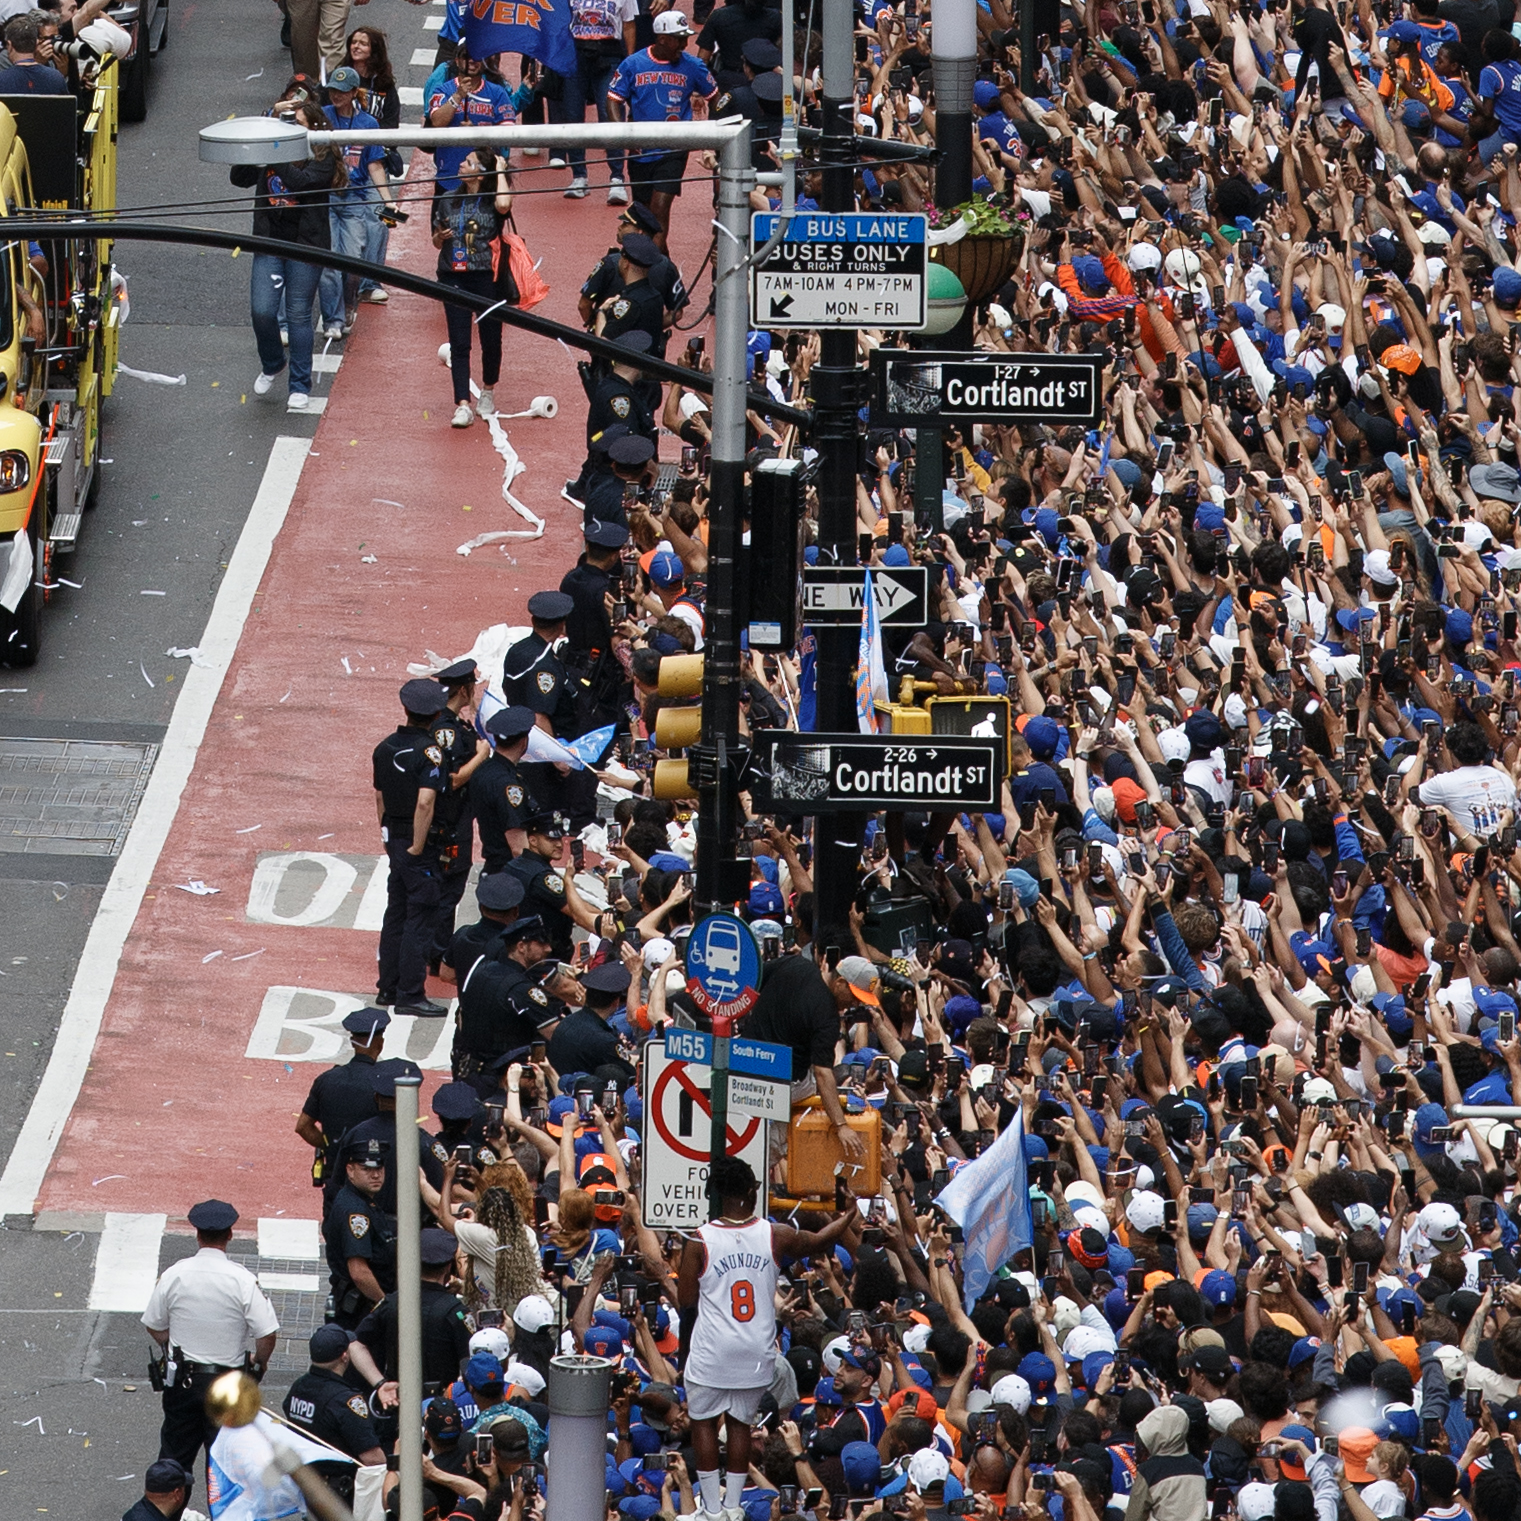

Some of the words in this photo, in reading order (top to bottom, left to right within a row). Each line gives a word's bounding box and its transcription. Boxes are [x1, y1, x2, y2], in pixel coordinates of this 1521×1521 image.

[635, 72, 659, 87] NEW
[660, 72, 688, 87] YORK
[807, 220, 846, 237] BUS
[853, 220, 909, 239] LANE
[770, 244, 846, 261] BUSES
[854, 244, 911, 262] ONLY
[792, 261, 802, 271] &
[807, 261, 842, 271] RIGHT
[846, 261, 886, 272] TURNS
[825, 301, 858, 316] MON
[874, 302, 899, 316] FRI
[993, 365, 1020, 378] 1-27
[947, 379, 1065, 408] Cortlandt
[1068, 381, 1088, 398] ST
[849, 586, 900, 609] WAY
[883, 747, 918, 763] 2-26
[835, 762, 963, 794] Cortlandt
[965, 765, 986, 784] ST
[686, 984, 706, 1004] NO
[705, 990, 756, 1017] STANDING
[668, 1033, 706, 1060] M55
[733, 1044, 755, 1061] South
[755, 1047, 776, 1064] Ferry
[731, 1078, 766, 1097] Broadway
[766, 1086, 774, 1096] &
[731, 1092, 765, 1108] Cortlandt
[765, 1097, 774, 1110] St
[653, 1203, 698, 1219] OVER
[713, 1252, 771, 1279] ANUNOBY
[730, 1279, 757, 1324] 8
[289, 1397, 315, 1418] NYPD
